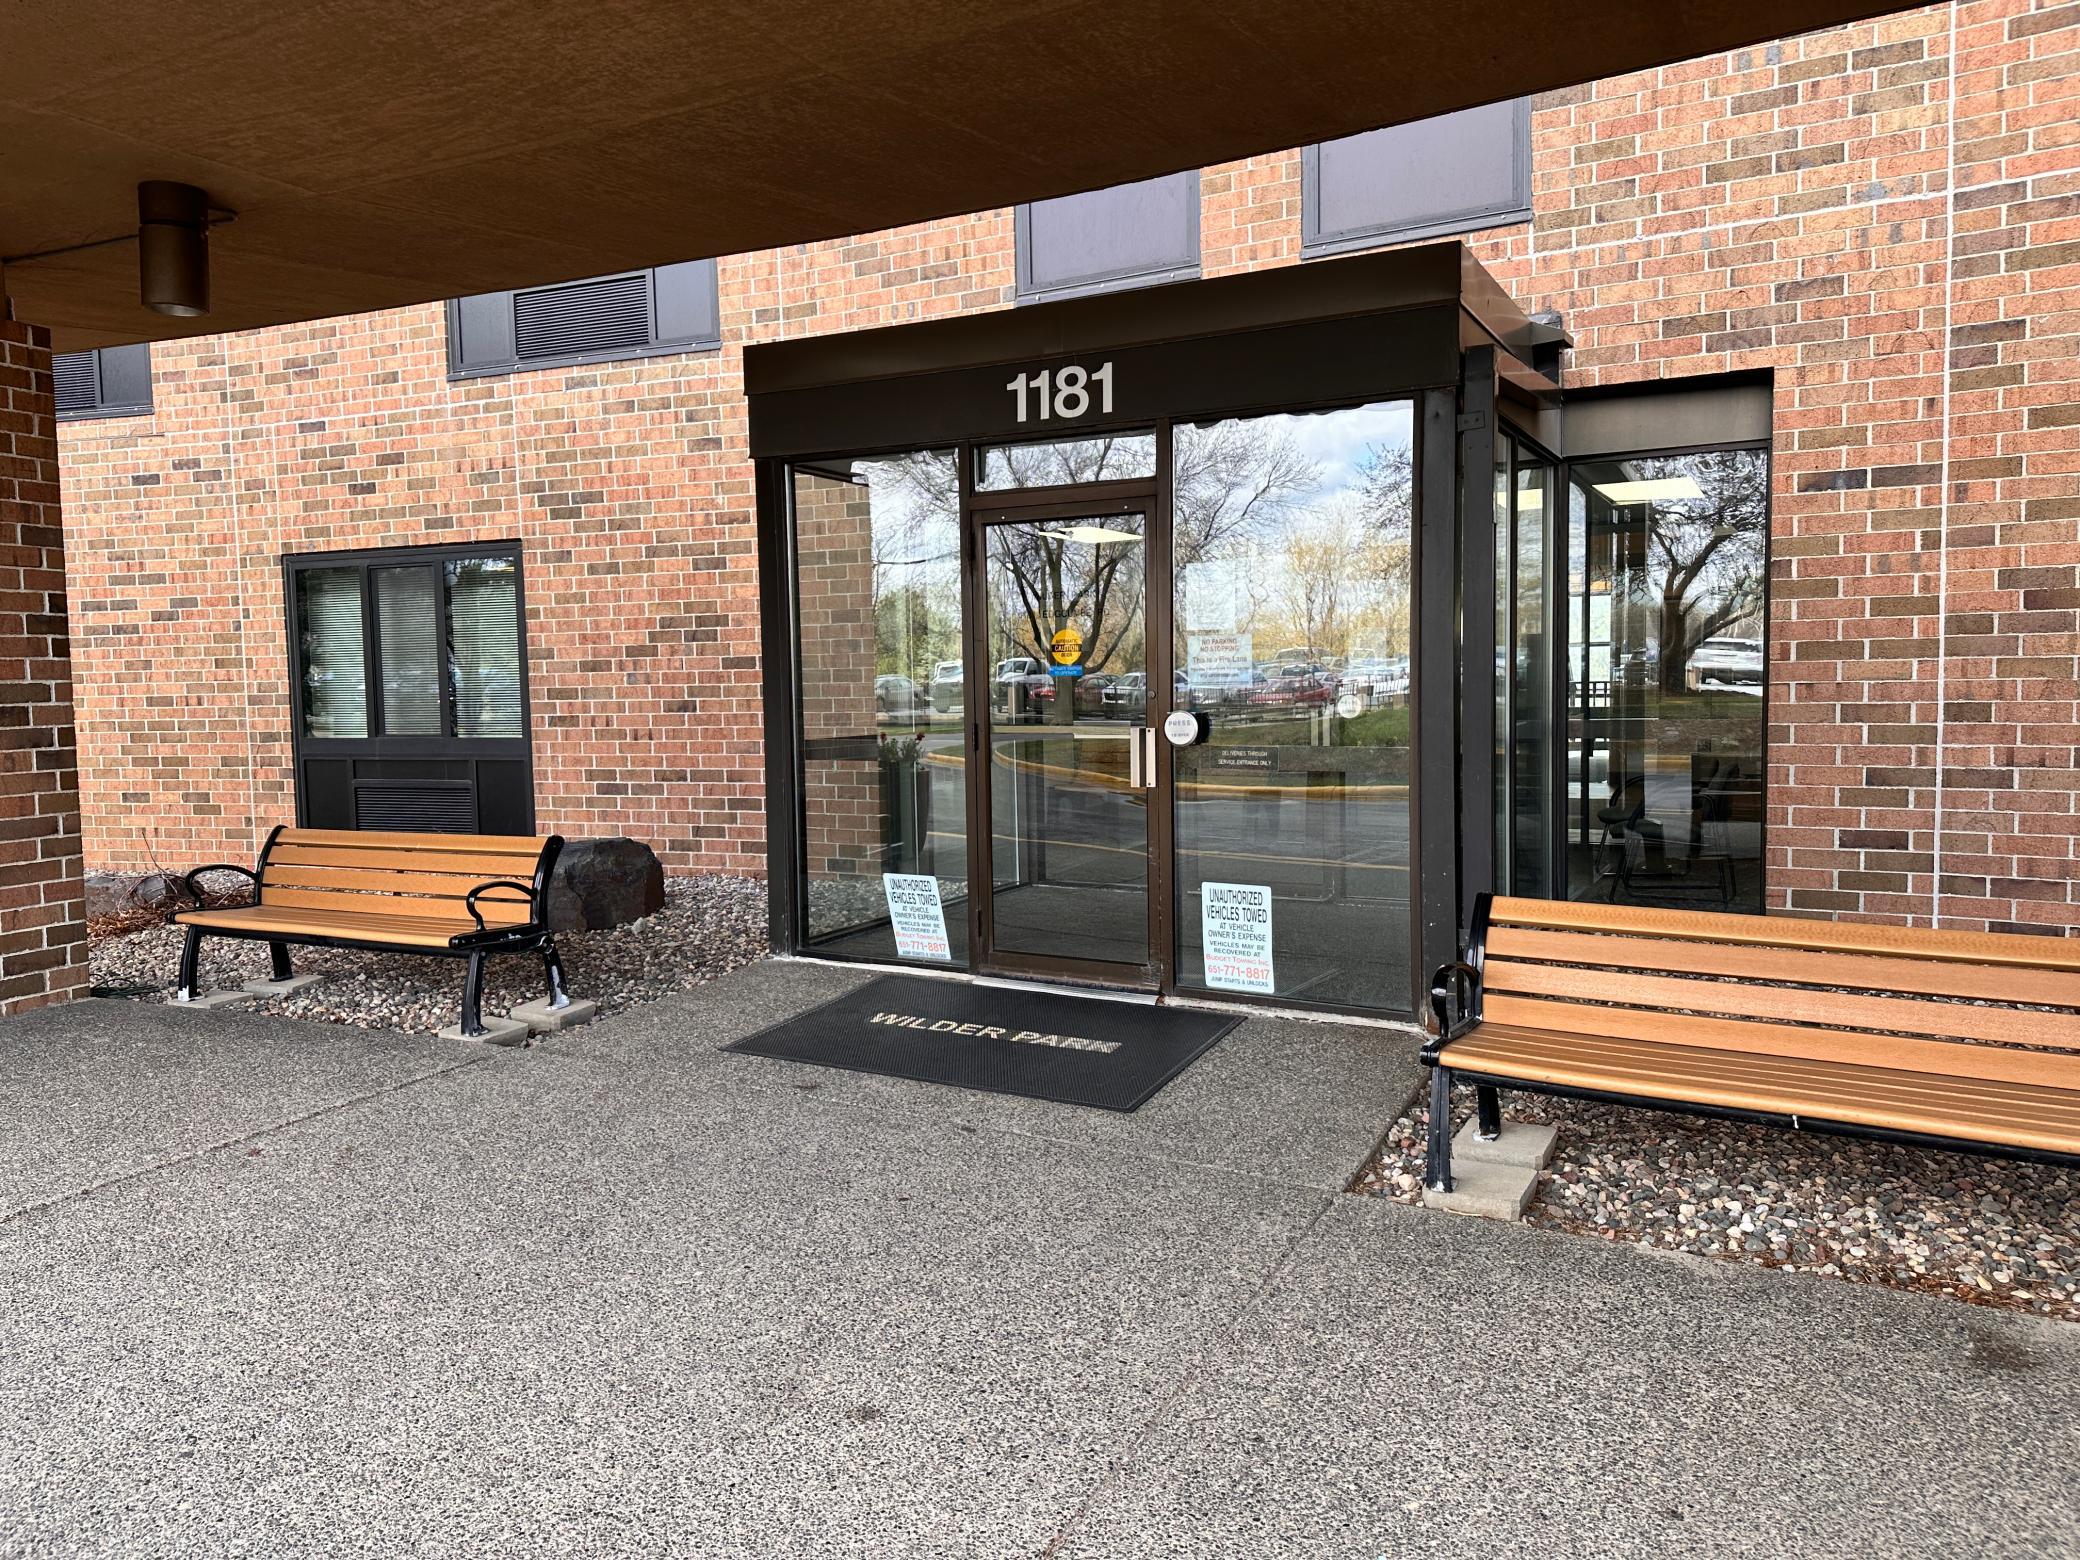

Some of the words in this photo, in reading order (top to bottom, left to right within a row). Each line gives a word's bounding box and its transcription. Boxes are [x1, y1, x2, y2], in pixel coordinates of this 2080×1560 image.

[1006, 362, 1112, 422] 1181
[890, 879, 932, 892] UNAUTHORIZED
[890, 892, 916, 905] VEHICLES
[917, 893, 938, 906] TOWED
[1209, 888, 1263, 906] UNAUTHORIZED
[894, 912, 916, 920] OWNER'S
[1207, 905, 1239, 921] VEHICLES
[1242, 908, 1267, 923] TOWED
[1229, 923, 1254, 932] VEHICLE
[1208, 930, 1235, 939] OWNER'S
[1238, 932, 1266, 942] EXPENSE
[899, 940, 946, 952] 651-771-8817
[1210, 940, 1239, 948] VEHICLES
[1214, 948, 1251, 956] RECOVERED
[1208, 965, 1270, 980] 651-771-8817
[870, 1012, 1006, 1039] WILDER
[1010, 1030, 1122, 1054] PARK
